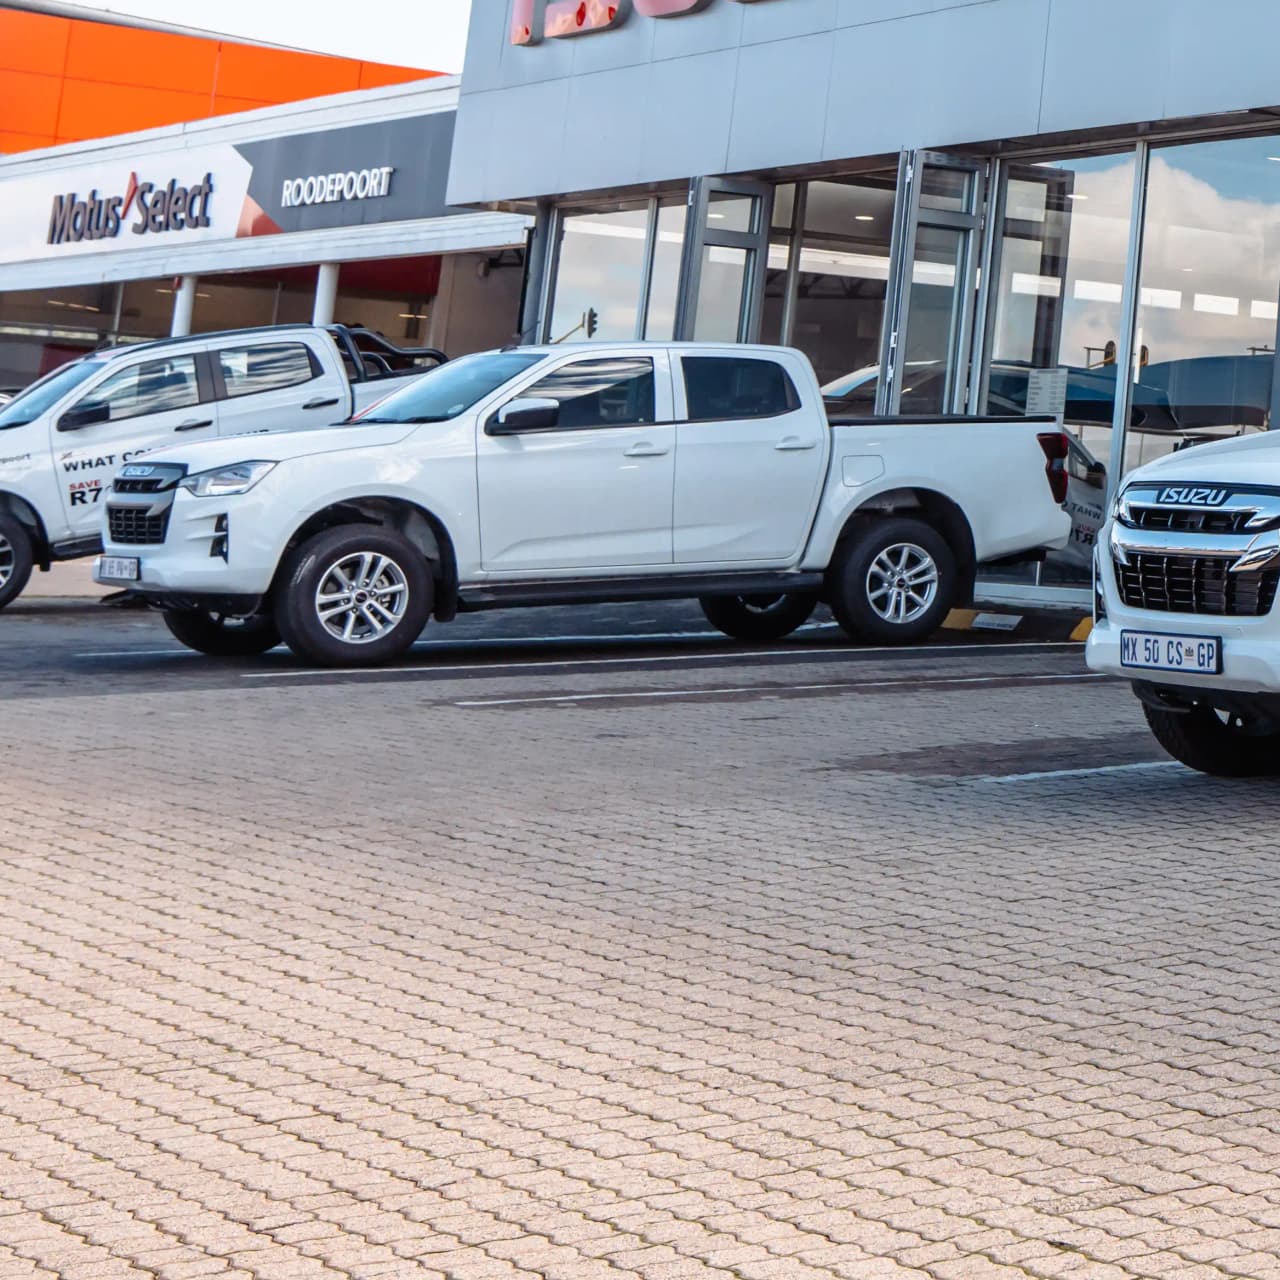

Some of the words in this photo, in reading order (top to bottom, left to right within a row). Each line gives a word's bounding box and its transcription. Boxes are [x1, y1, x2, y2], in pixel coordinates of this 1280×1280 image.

[281, 166, 394, 208] ROODEPOORT
[47, 189, 122, 245] Motus
[132, 172, 213, 235] Select
[64, 455, 116, 472] WHAT
[69, 479, 101, 491] SAVE
[71, 486, 111, 506] R7
[1159, 487, 1227, 505] ISUZU
[1123, 637, 1138, 662] MX
[1144, 638, 1160, 664] 50
[1166, 640, 1183, 666] CS
[1197, 642, 1215, 668] GP
